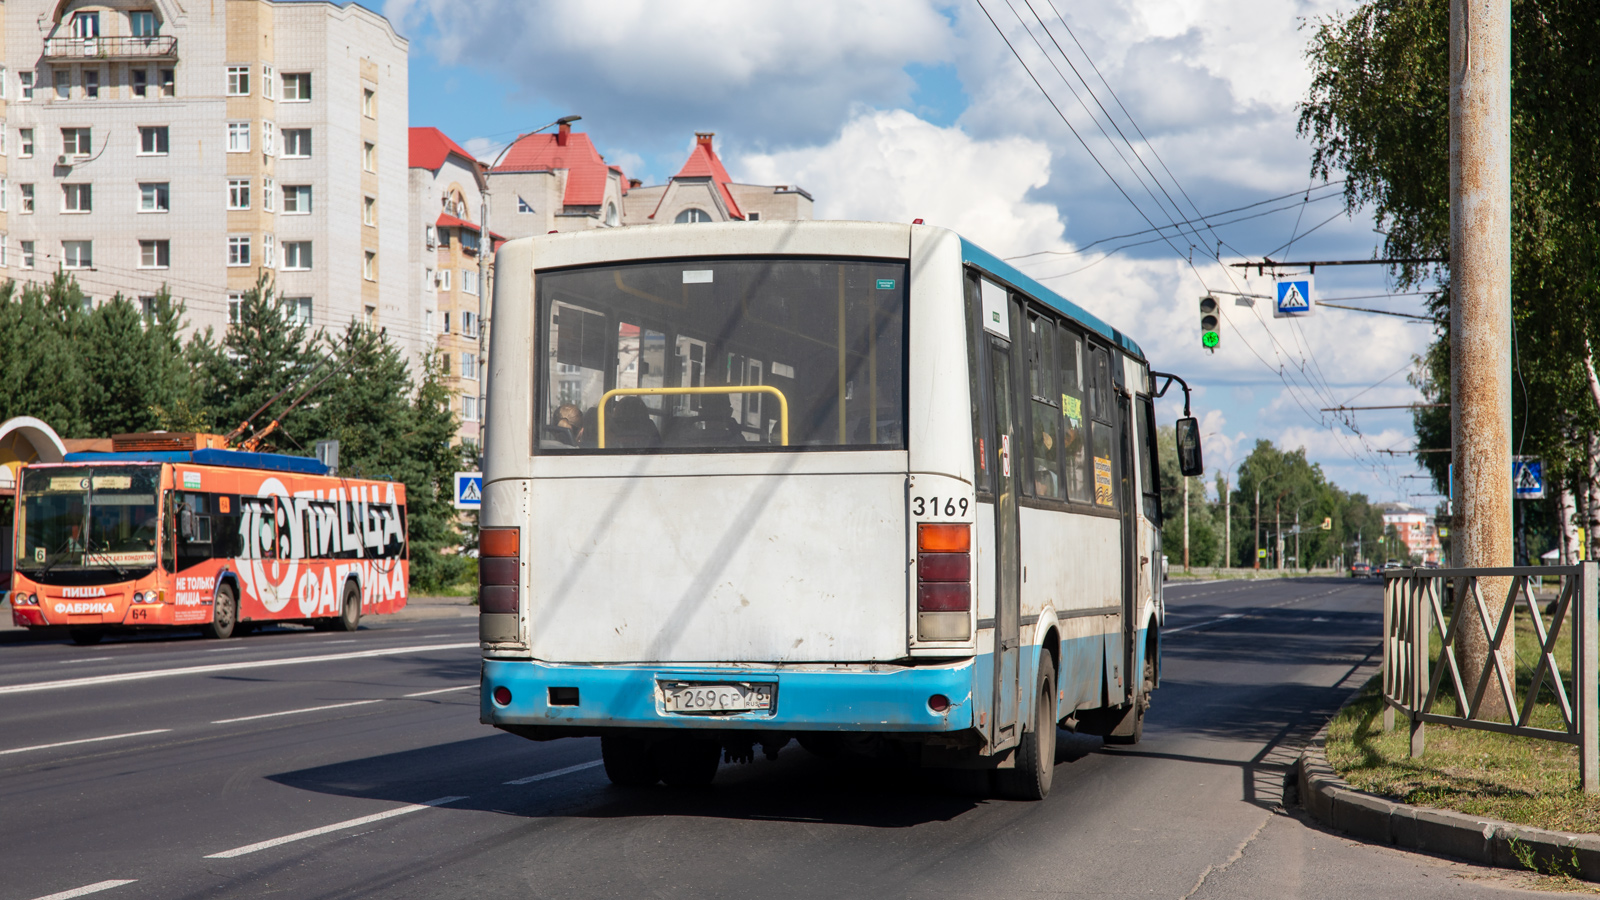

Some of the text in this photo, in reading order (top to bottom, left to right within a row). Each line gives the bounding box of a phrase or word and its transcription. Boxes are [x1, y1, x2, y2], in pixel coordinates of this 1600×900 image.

[913, 497, 969, 517] 3169
[293, 484, 405, 559] ПИЦЦА
[36, 550, 44, 561] 6
[176, 576, 215, 590] НЕ ТОЛЬКО
[62, 587, 107, 598] ПИЦЦА
[176, 592, 200, 607] ПИЦЦА
[54, 602, 115, 613] ФАБРИКА
[132, 608, 147, 620] 64
